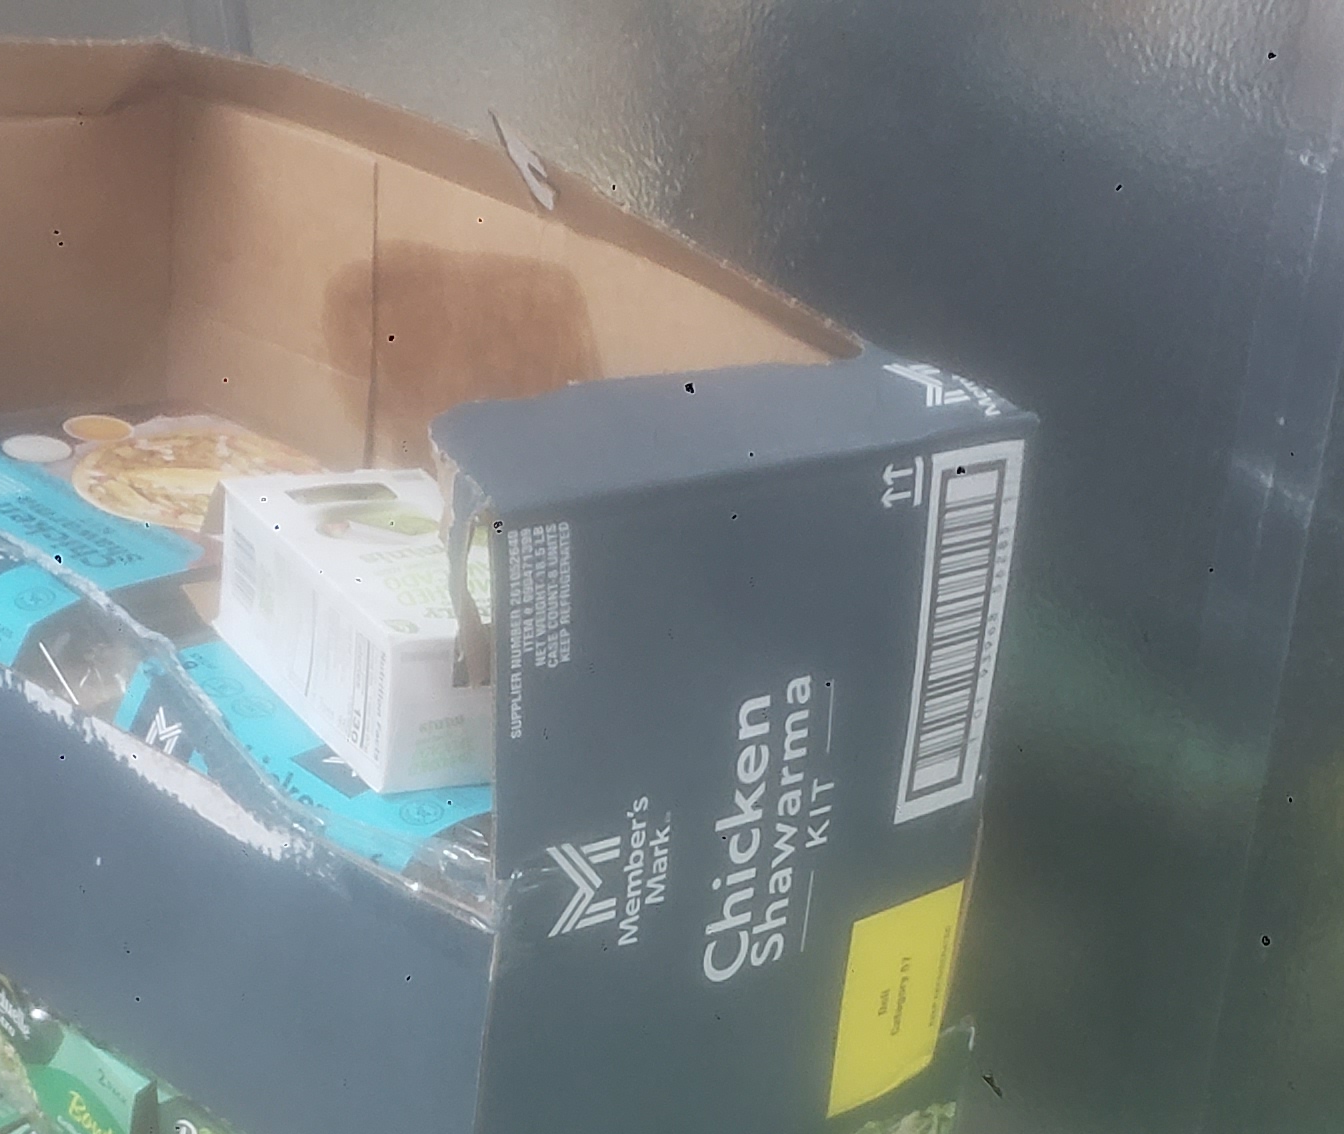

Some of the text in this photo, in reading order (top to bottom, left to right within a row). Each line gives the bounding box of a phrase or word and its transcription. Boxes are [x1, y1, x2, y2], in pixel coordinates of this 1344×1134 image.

[532, 525, 546, 543] LB
[545, 523, 557, 565] UNITS
[558, 521, 571, 662] KEEP REFRIGERATED
[510, 609, 522, 669] NUMBER
[523, 618, 534, 653] ITEM
[535, 641, 546, 667] NET
[546, 634, 558, 668] CASE
[510, 671, 522, 739] SUPPLIER
[703, 694, 771, 983] Chicken
[750, 675, 811, 967] Shawarma
[805, 778, 834, 848] KIT
[617, 796, 649, 946] Member's
